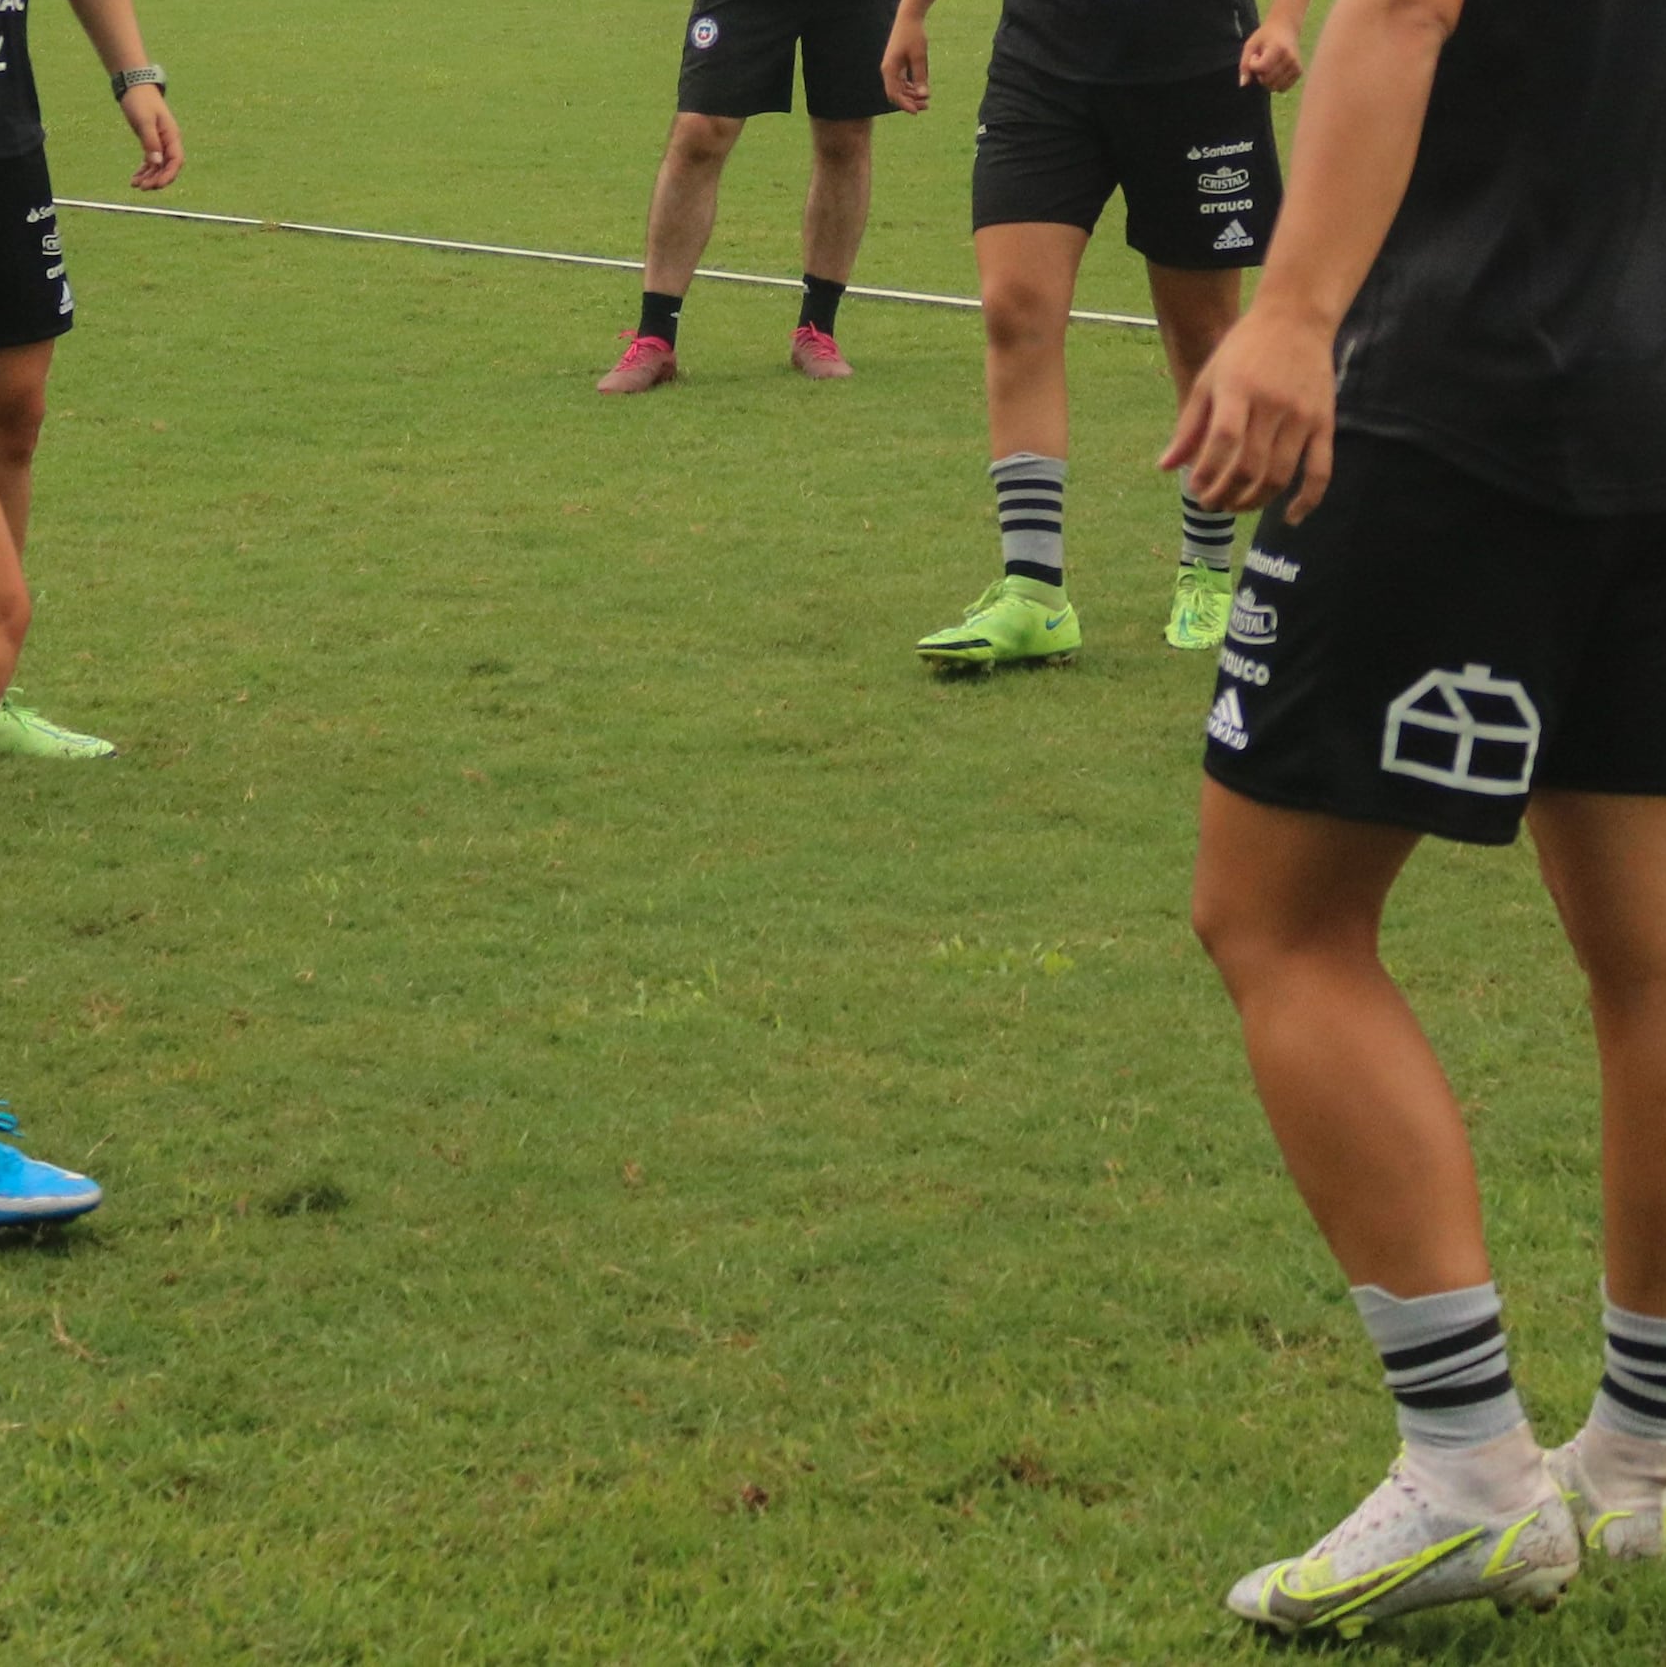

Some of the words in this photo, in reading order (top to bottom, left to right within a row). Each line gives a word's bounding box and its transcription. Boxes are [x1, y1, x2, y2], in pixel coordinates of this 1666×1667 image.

[1202, 141, 1254, 159] Santander
[1203, 175, 1245, 190] CRISTAL
[1200, 199, 1253, 214] arauco
[1213, 236, 1254, 250] adidas
